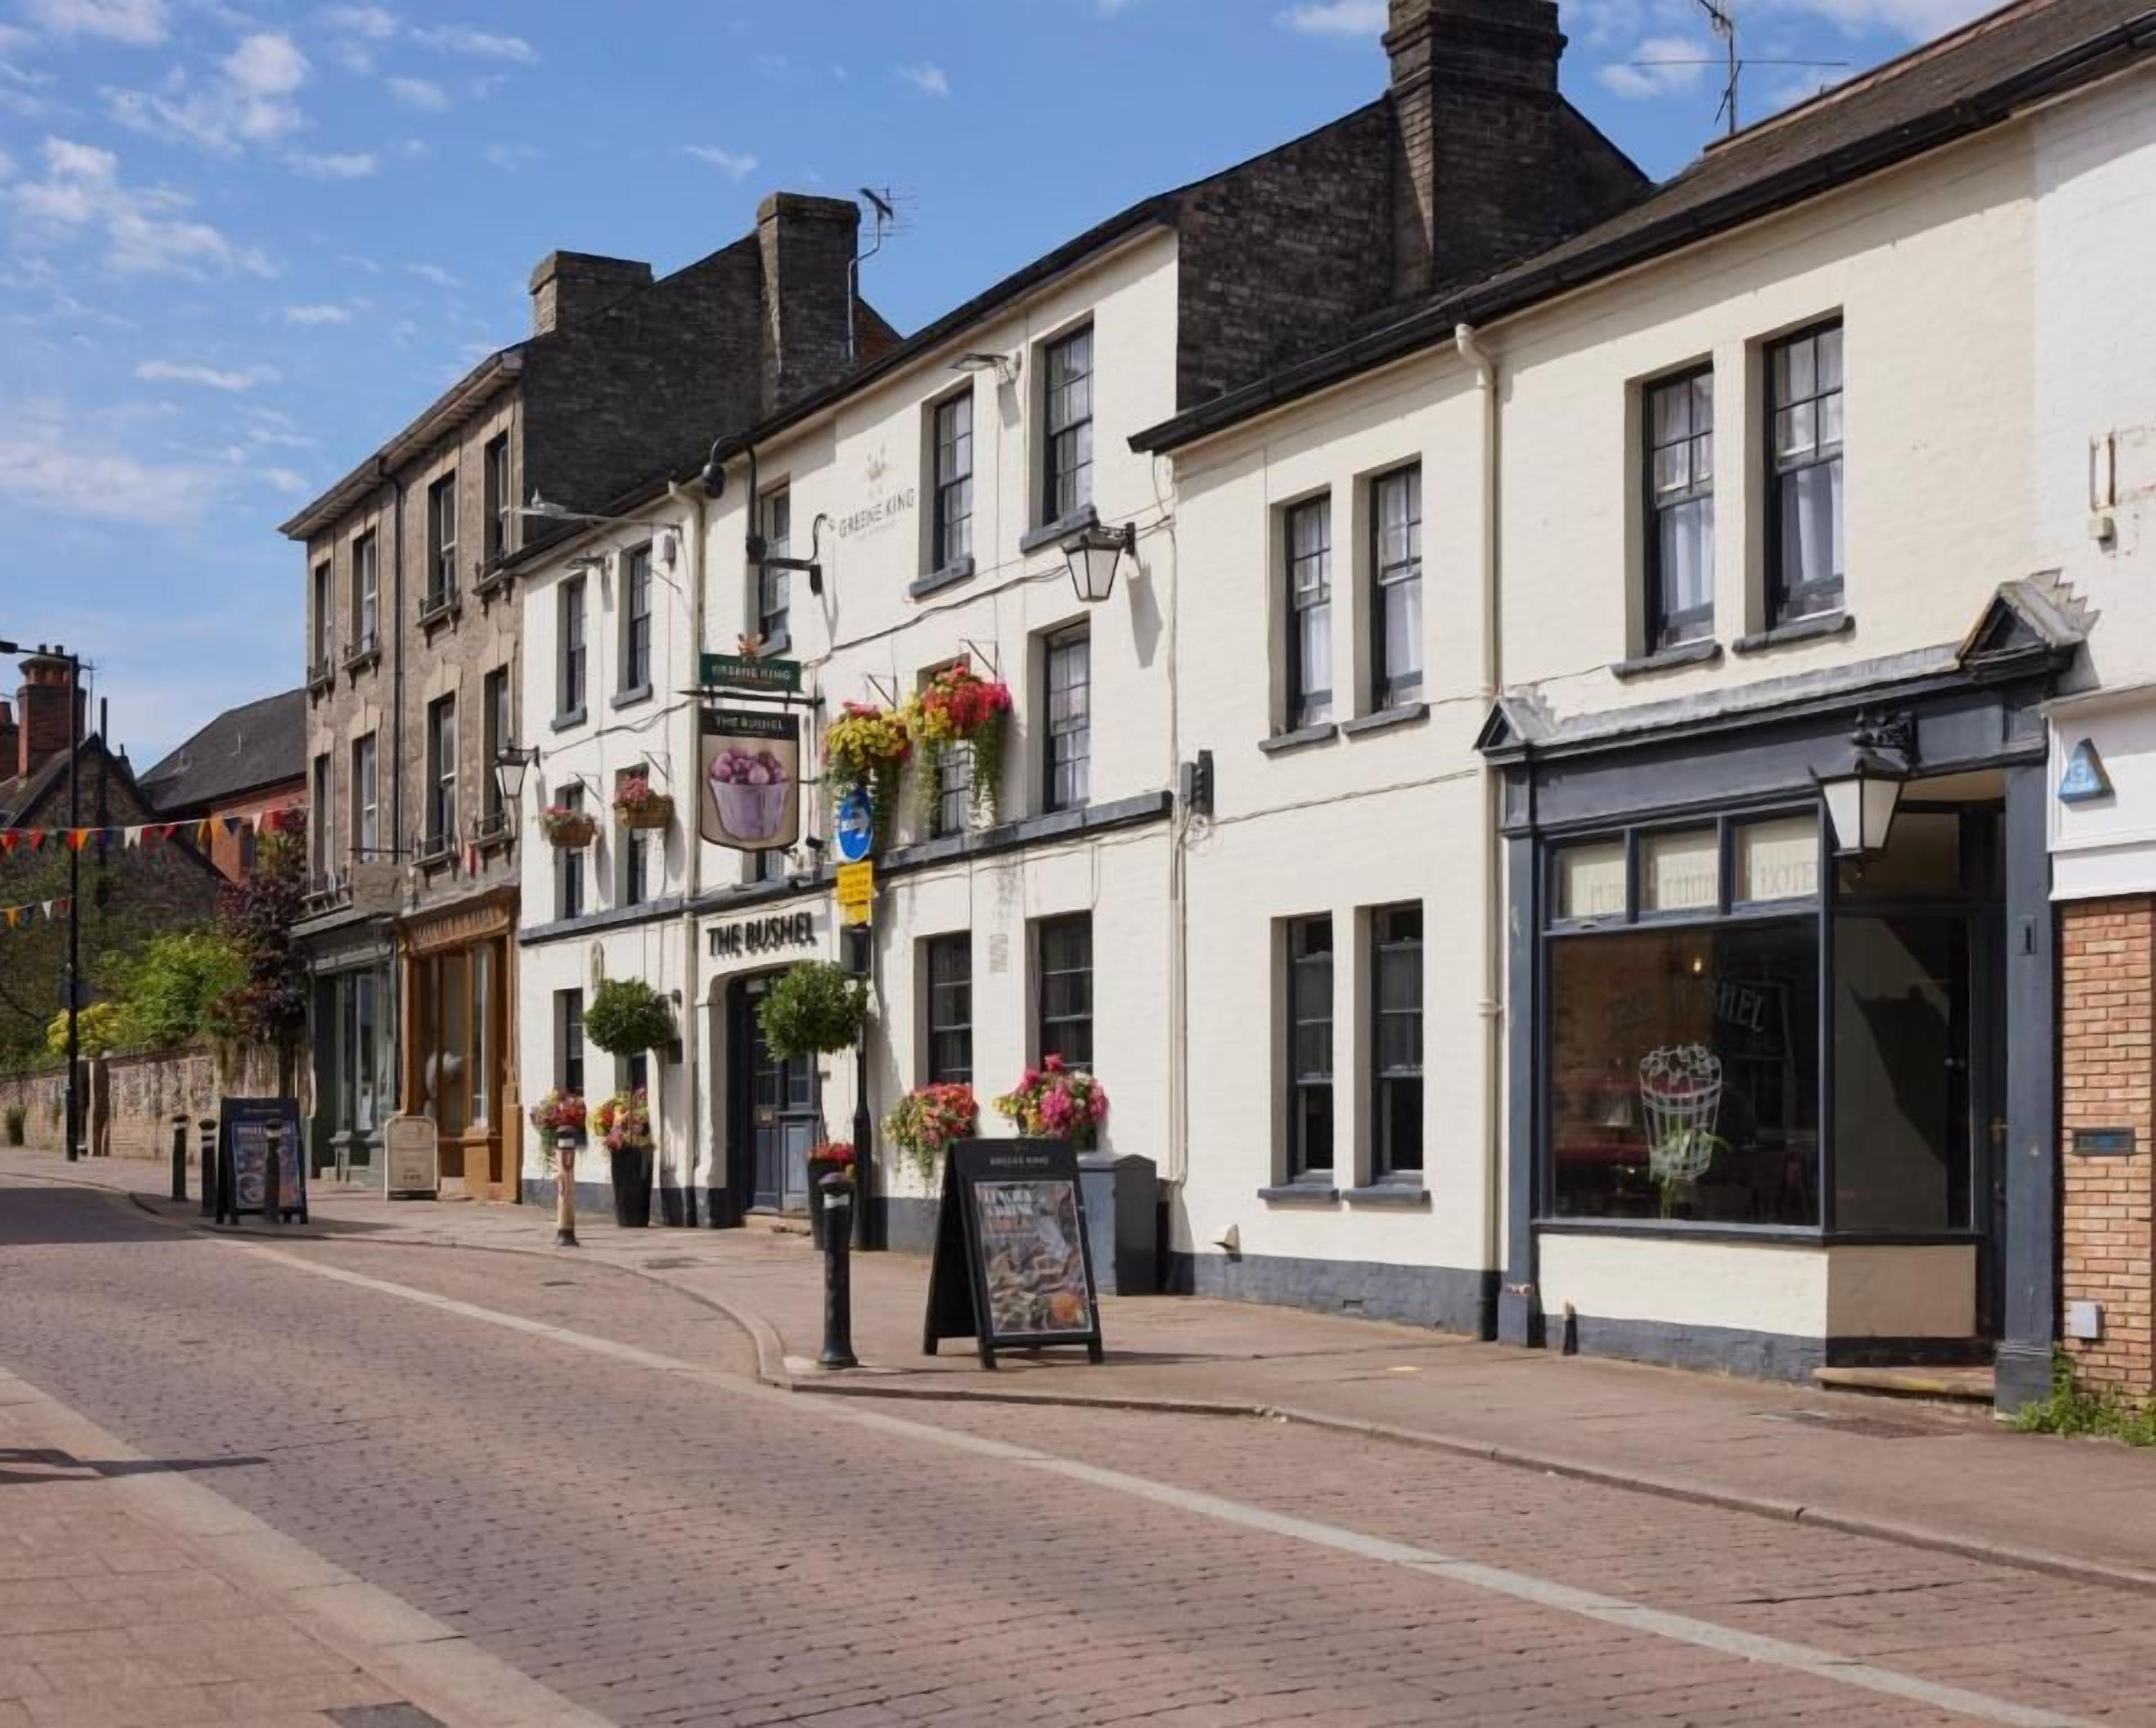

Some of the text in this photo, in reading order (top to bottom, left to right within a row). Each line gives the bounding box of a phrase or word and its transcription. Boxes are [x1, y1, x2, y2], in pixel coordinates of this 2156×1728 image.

[887, 488, 914, 516] KING
[707, 911, 816, 956] THE BUSHEL
